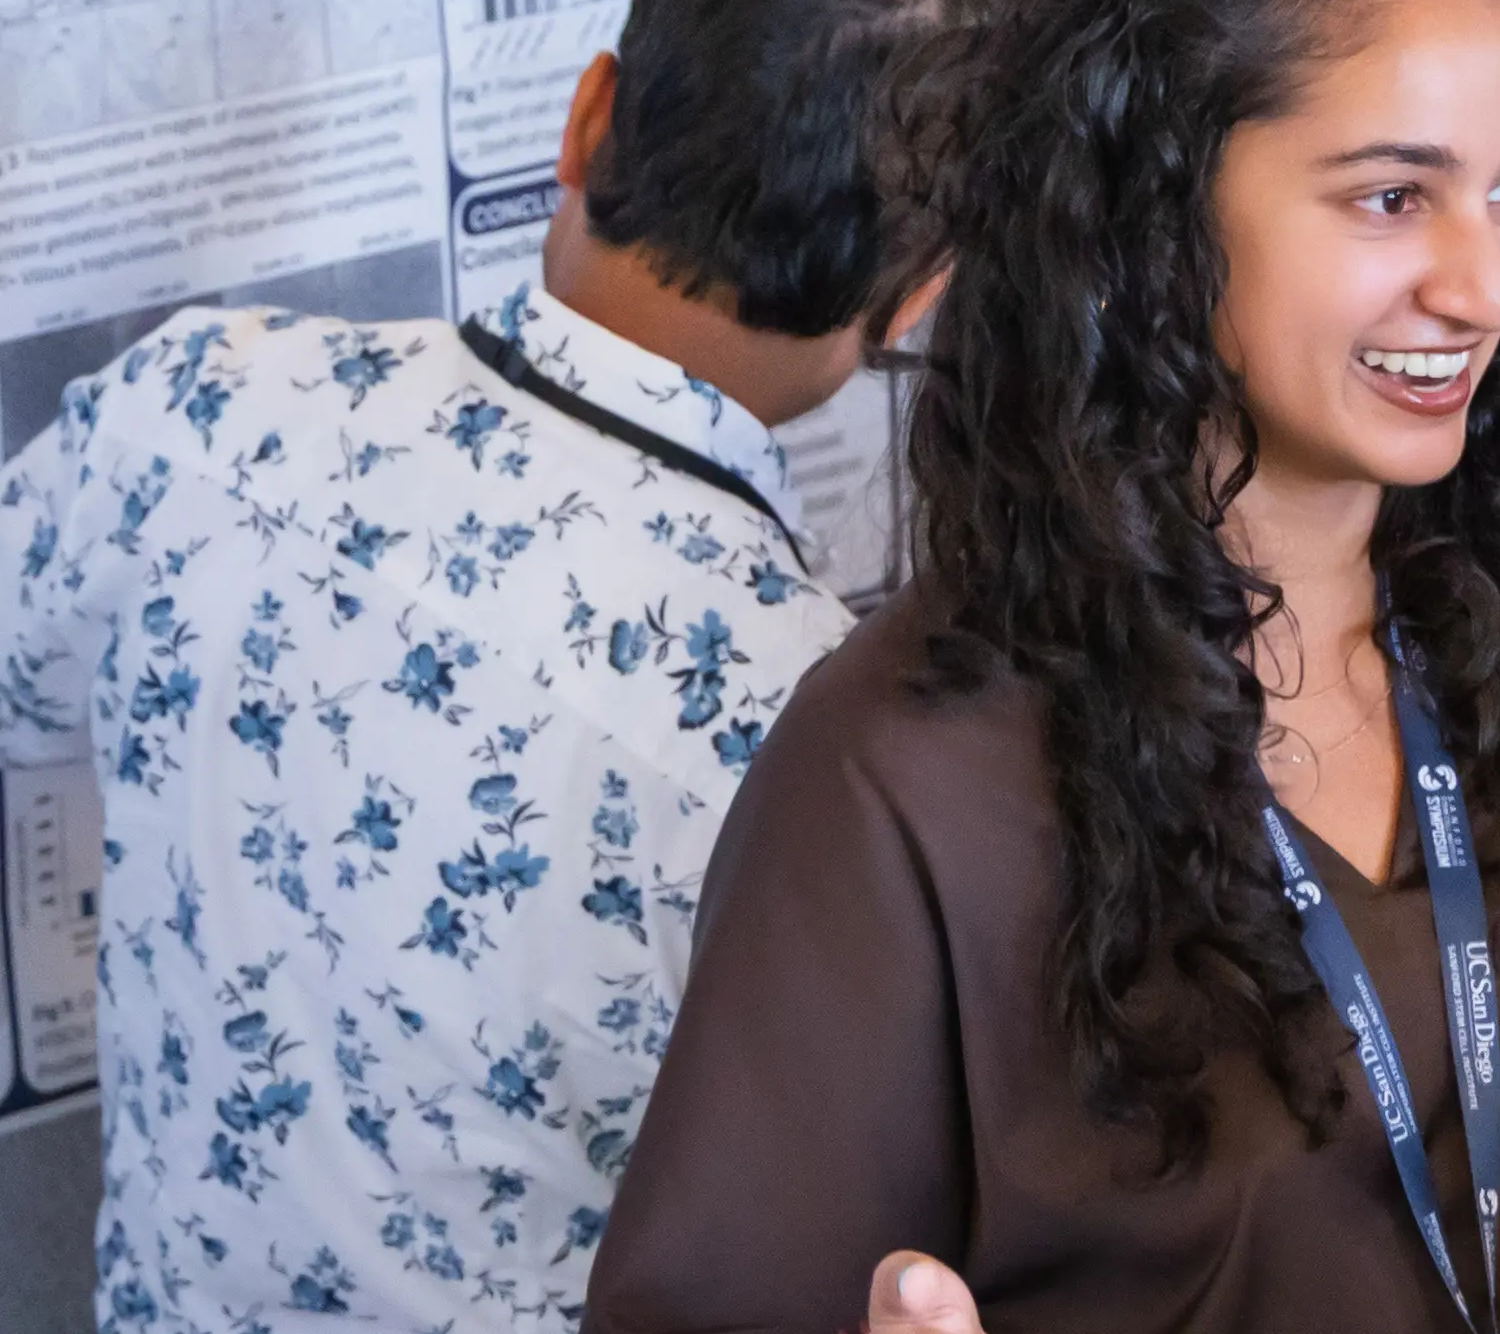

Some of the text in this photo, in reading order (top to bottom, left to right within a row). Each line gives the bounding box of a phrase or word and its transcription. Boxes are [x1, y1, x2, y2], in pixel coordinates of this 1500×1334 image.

[1426, 795, 1453, 868] SYMPOSIUM
[1346, 1000, 1409, 1144] UC San Diego
[1466, 940, 1497, 1084] UC San Diego
